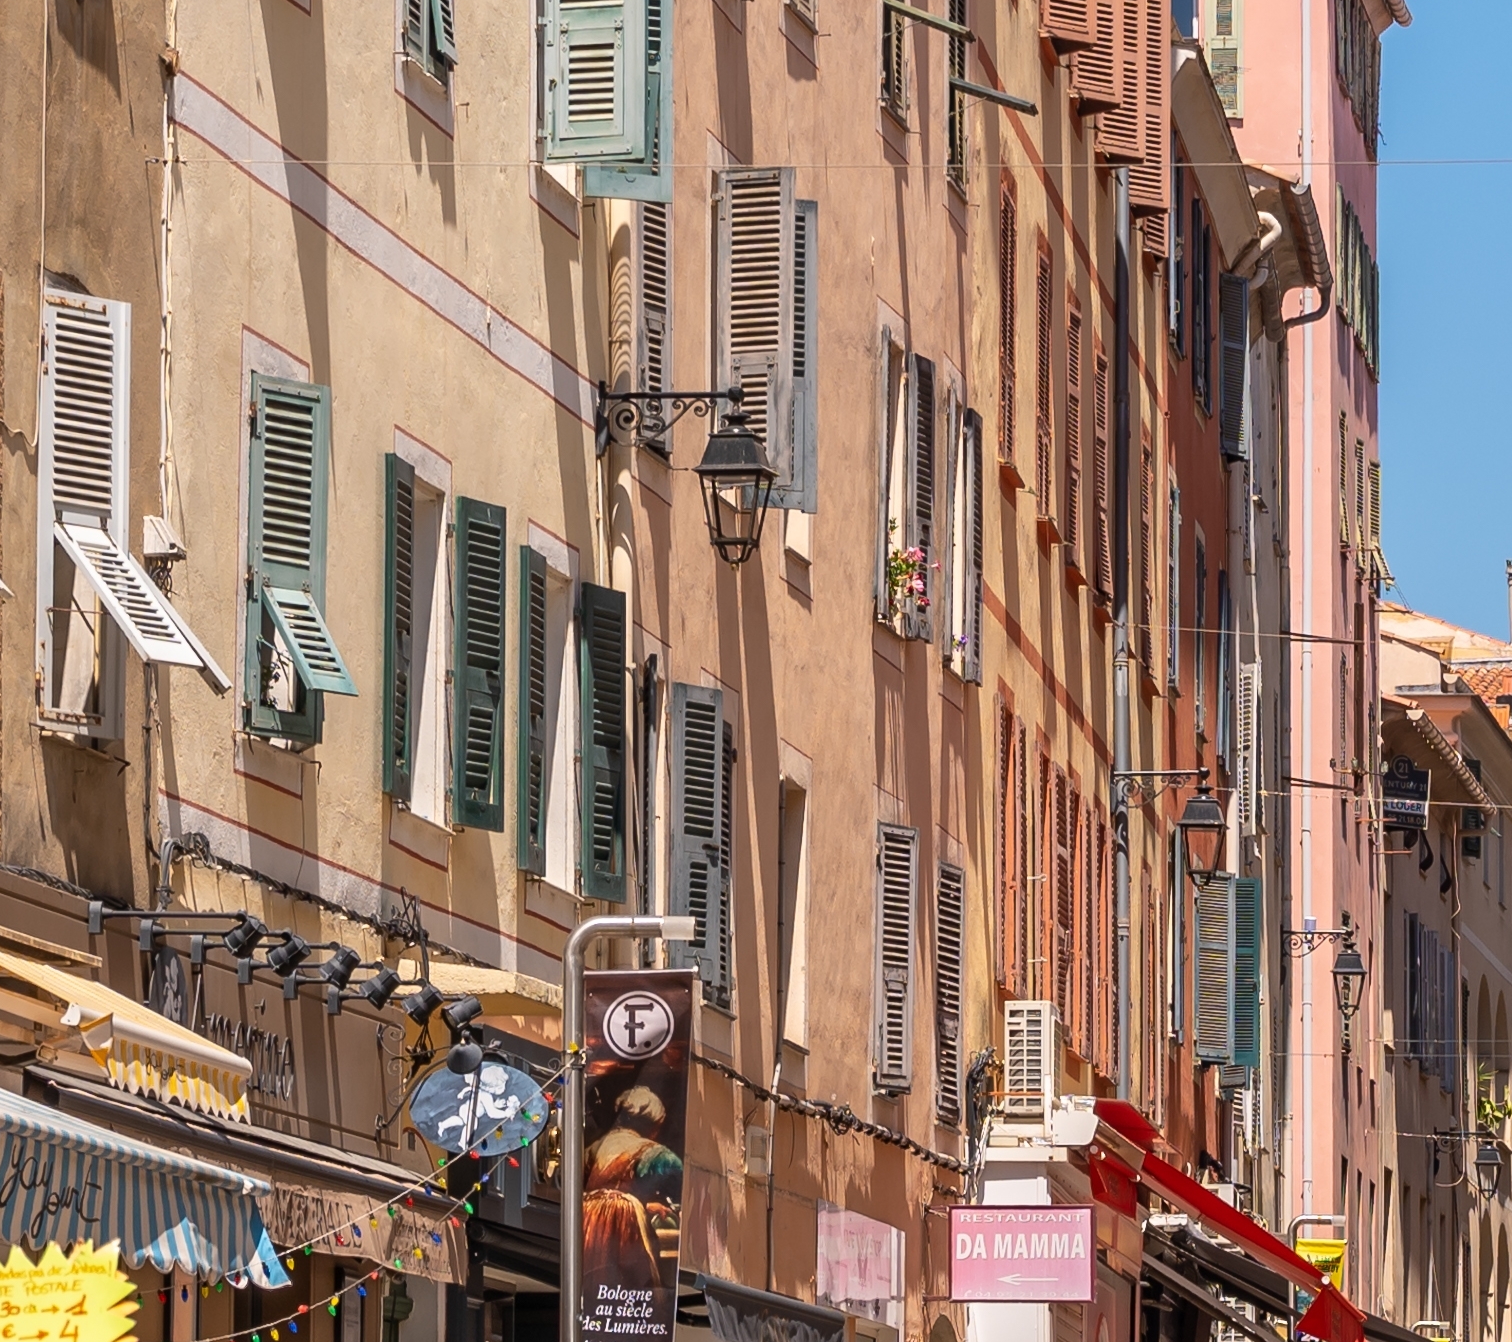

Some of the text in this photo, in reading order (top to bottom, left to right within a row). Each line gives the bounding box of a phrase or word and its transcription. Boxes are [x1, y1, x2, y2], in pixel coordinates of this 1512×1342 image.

[960, 1213, 1085, 1223] RESTAURANT
[956, 1234, 1086, 1260] DA MAMMA
[23, 1279, 83, 1297] POSTALE
[597, 1284, 653, 1305] Bologne
[595, 1302, 653, 1318] au siècle
[604, 1317, 668, 1335] Lumières.
